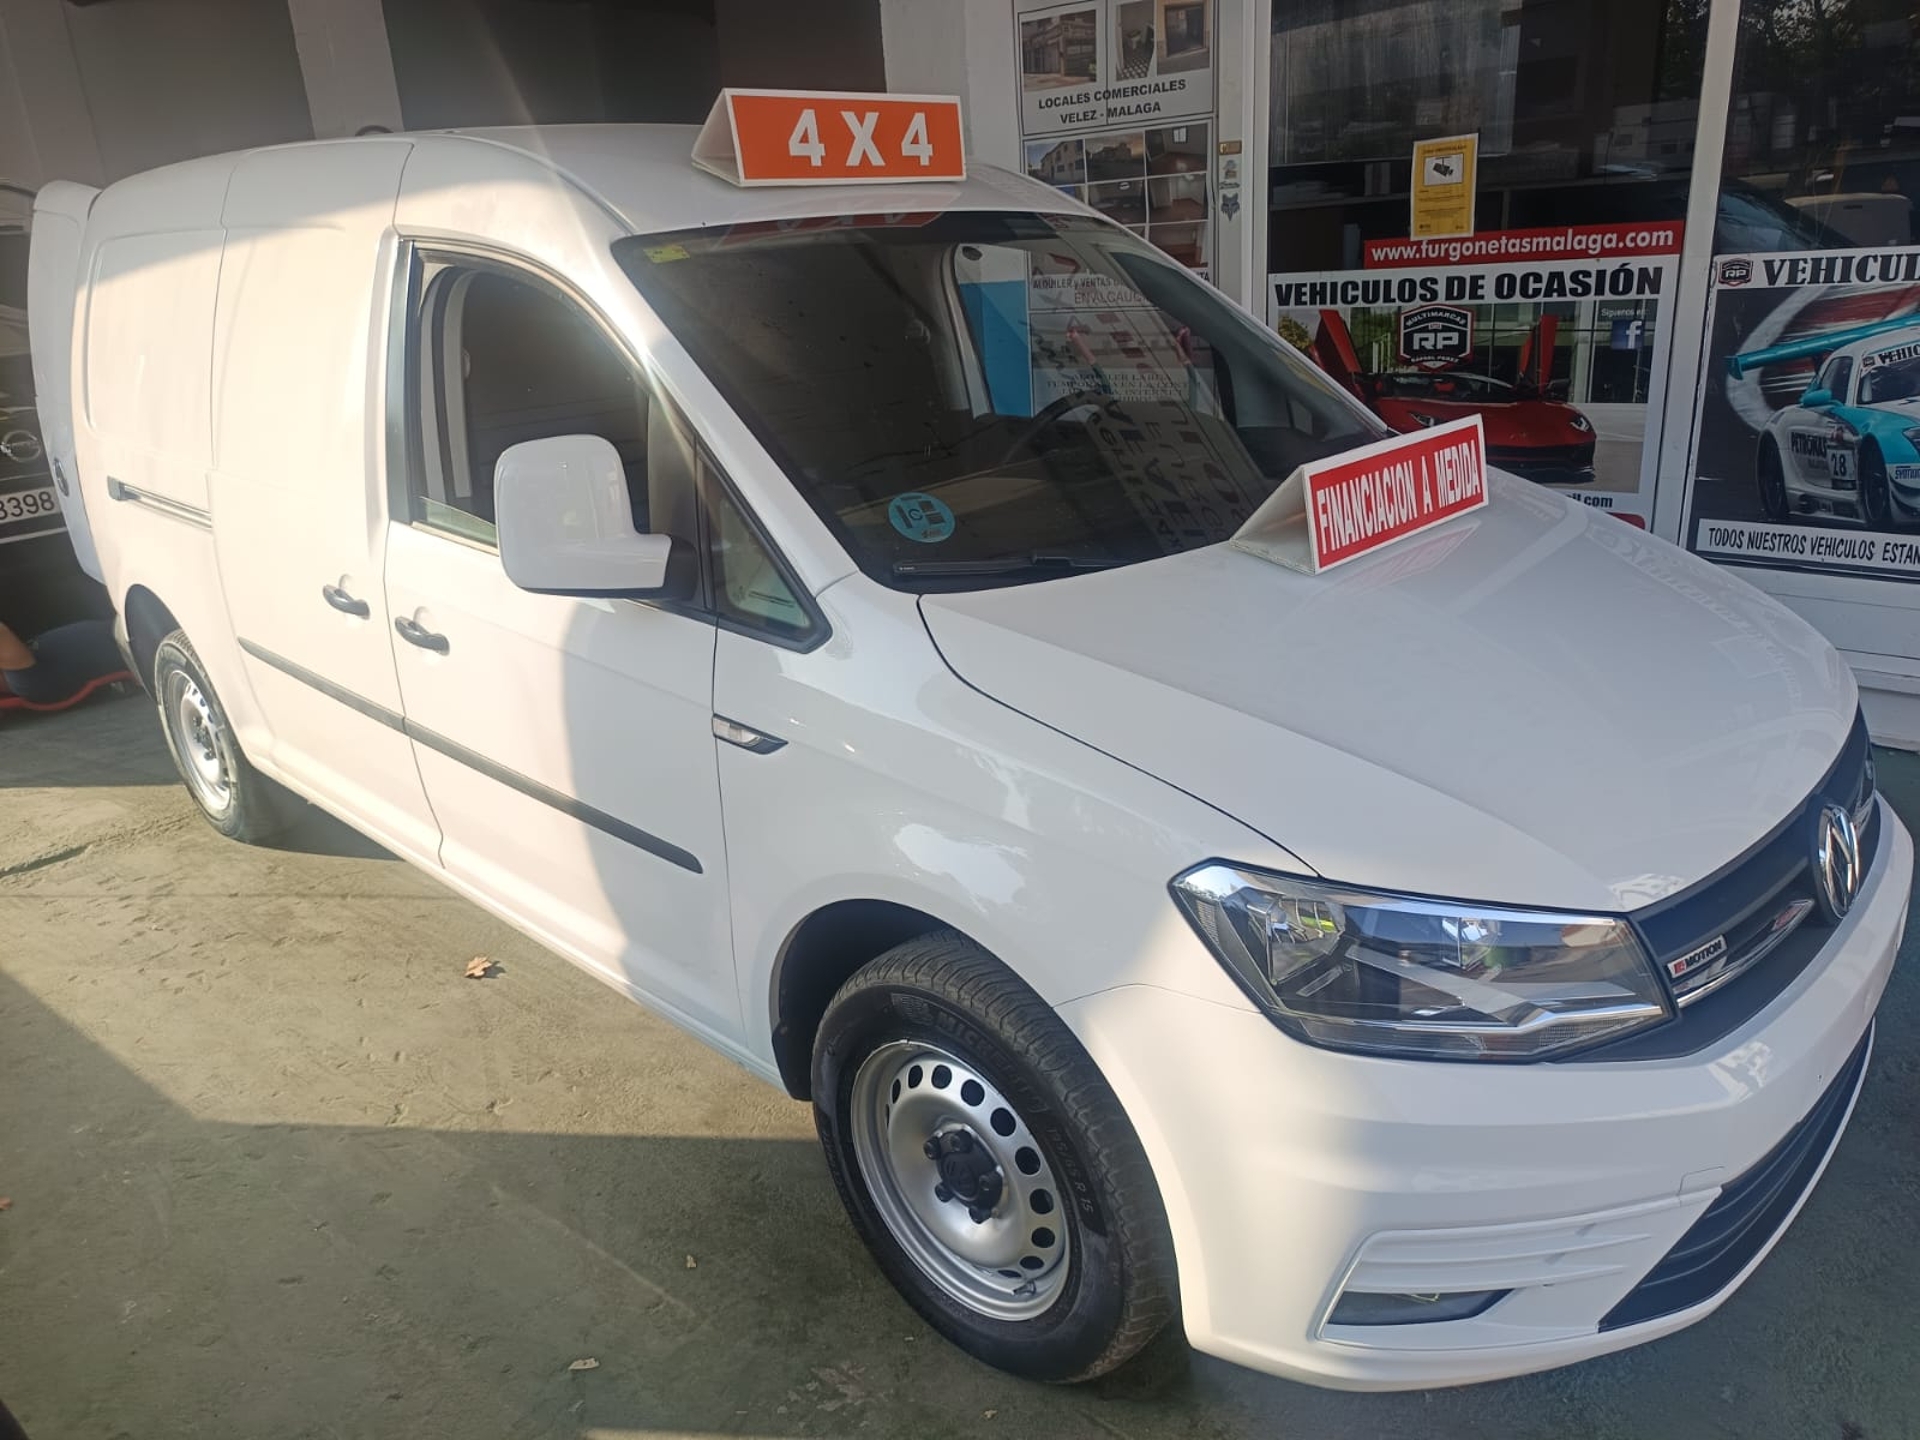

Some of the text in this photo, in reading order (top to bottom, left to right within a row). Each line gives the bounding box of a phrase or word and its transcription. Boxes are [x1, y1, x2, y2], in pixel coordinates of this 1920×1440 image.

[1038, 79, 1187, 109] LOCALES COMERCIALES
[1060, 109, 1097, 124] VELEZ
[1107, 101, 1161, 118] MALAGA
[788, 109, 934, 166] 4 X 4
[1371, 229, 1674, 263] www.furgonetasmalaga.com
[1275, 262, 1663, 307] VEHICULOS DE OCASIÓN
[1413, 332, 1459, 350] RP
[1317, 440, 1481, 554] FINANCIACION A MEDIDA
[1709, 528, 1744, 549] TODOS
[1747, 530, 1807, 555] NUESTROS
[1811, 536, 1875, 560] VEHICULOS
